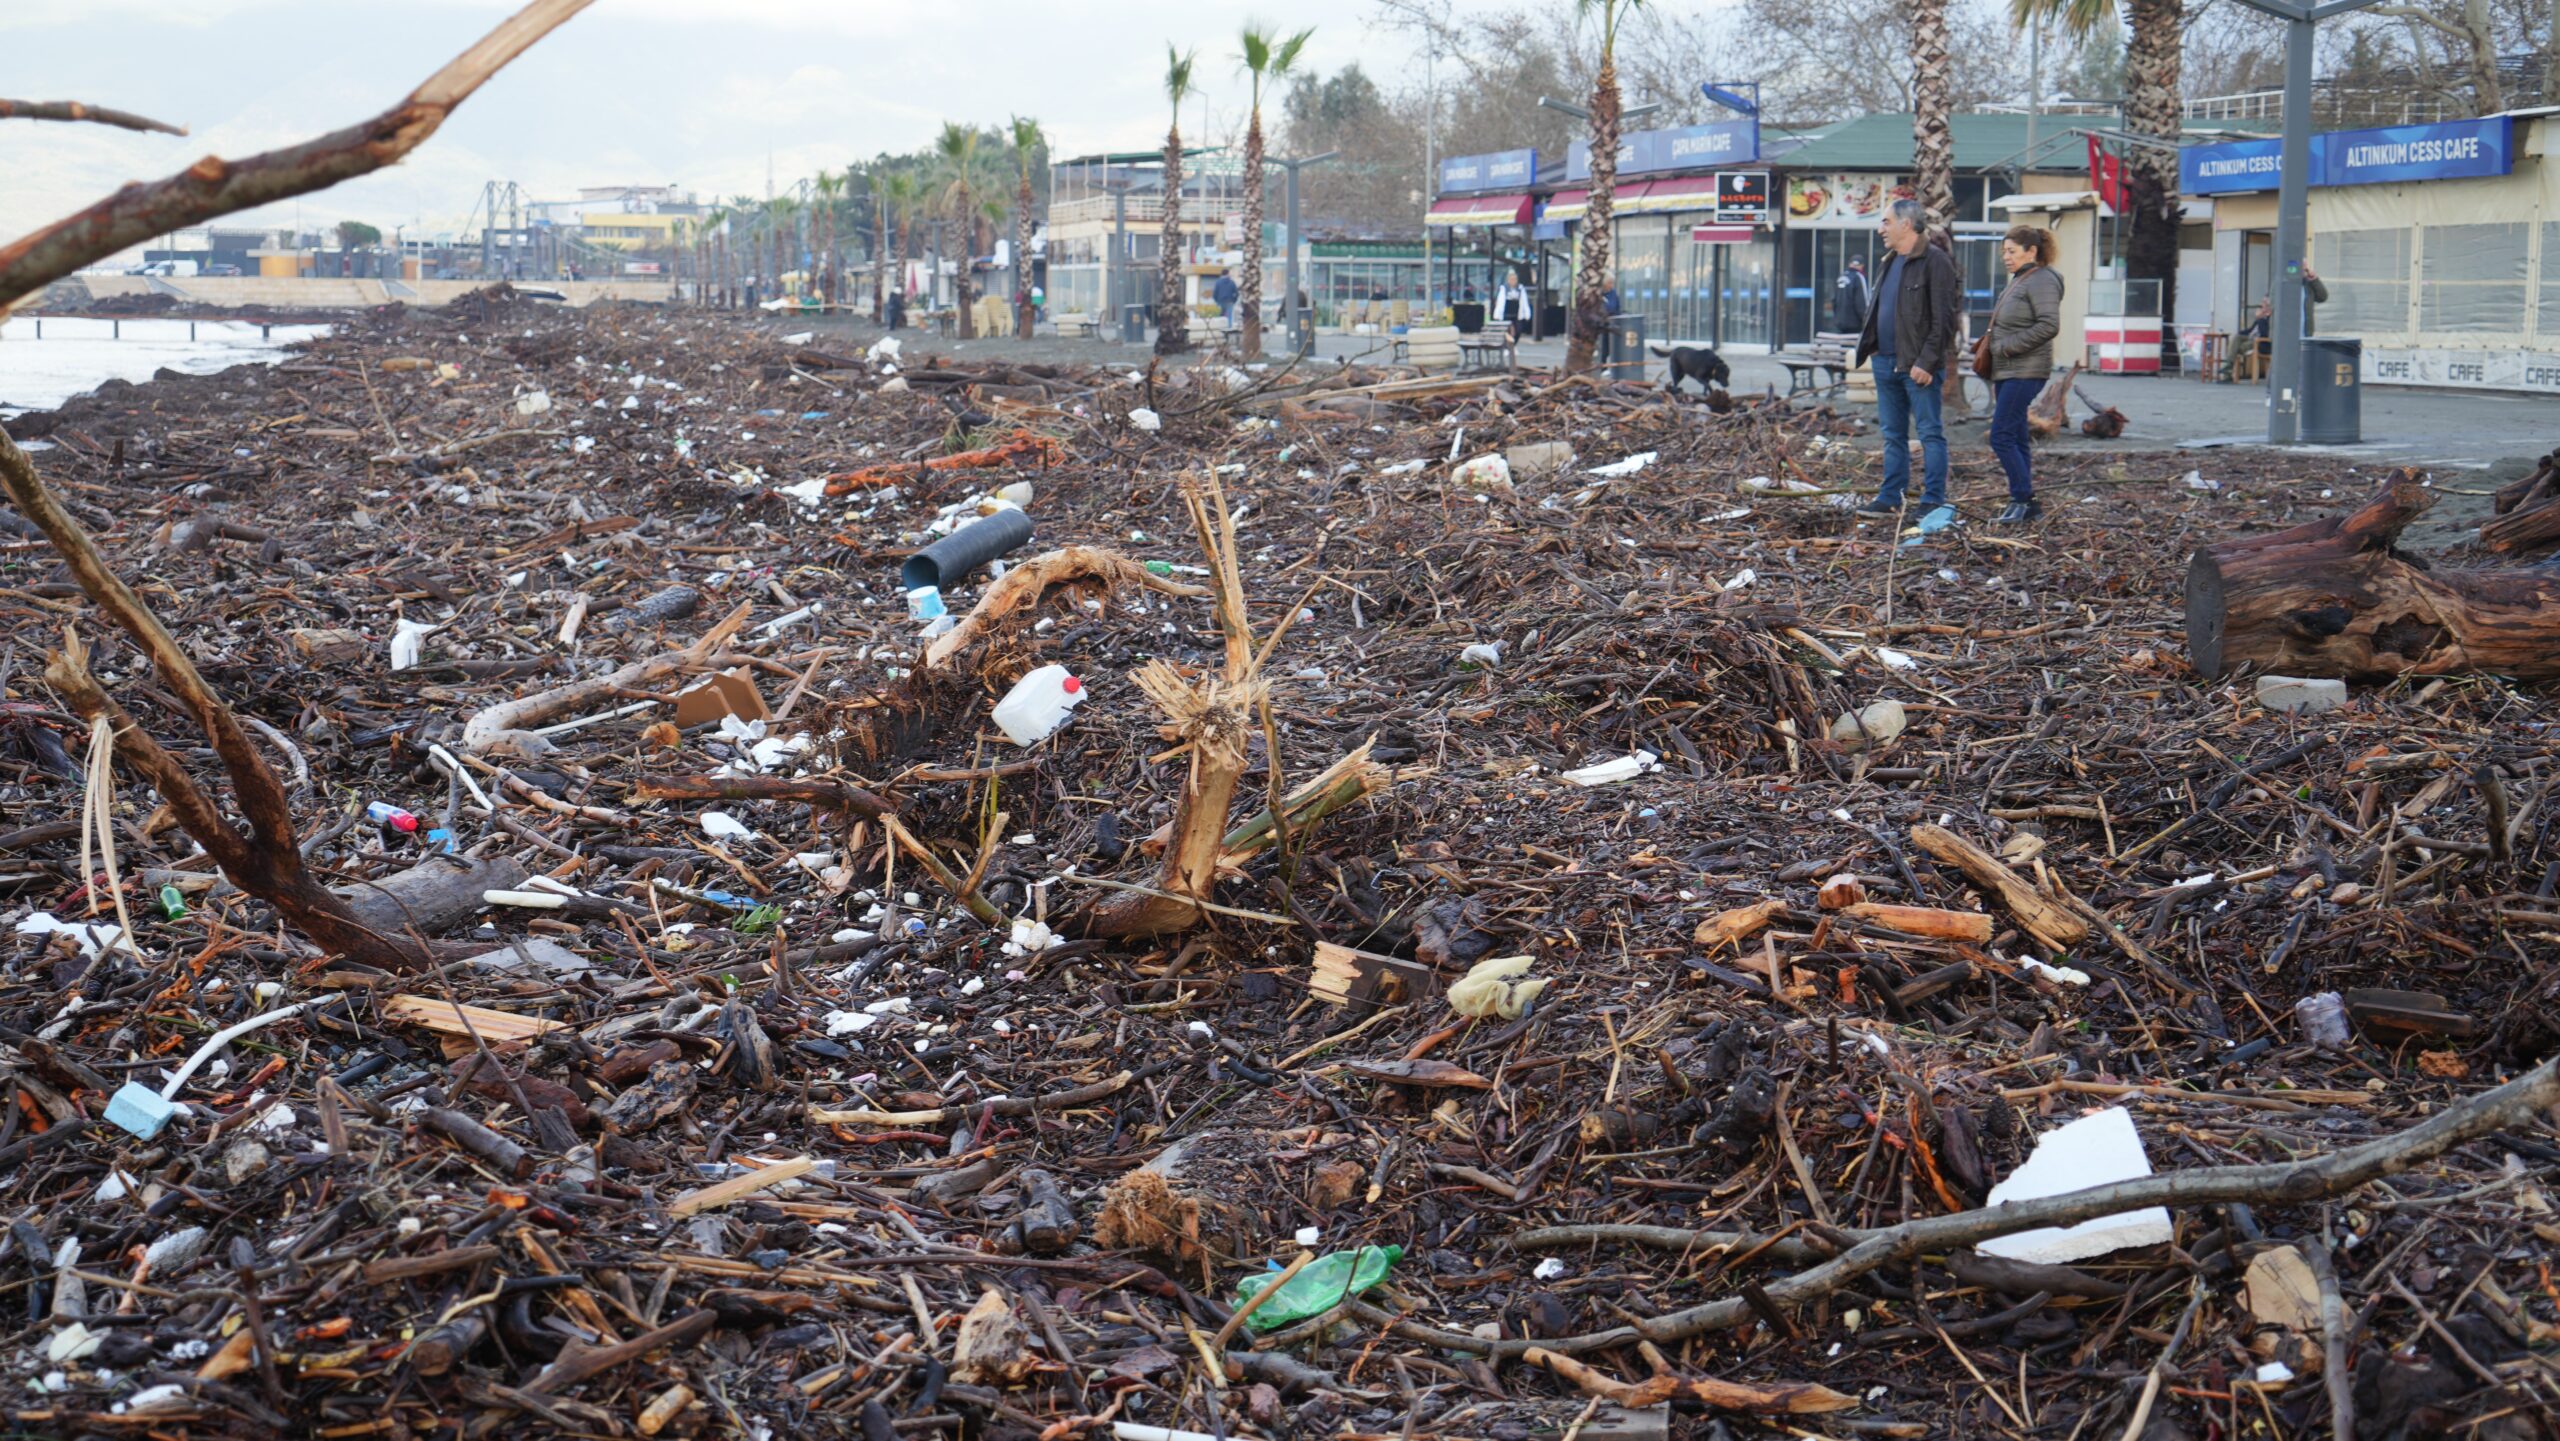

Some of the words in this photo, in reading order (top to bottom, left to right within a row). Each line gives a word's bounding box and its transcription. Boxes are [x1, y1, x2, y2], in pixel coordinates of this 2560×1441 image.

[1713, 132, 1732, 152] CAFE
[2347, 142, 2407, 168] ALTINKUM
[2410, 139, 2441, 162] CESS
[2444, 136, 2479, 161] CAFE
[2199, 159, 2247, 177] ALTINKUM
[2249, 156, 2275, 173] CESS
[2378, 361, 2409, 377] CAFE
[2449, 364, 2483, 381] CAFE
[2526, 367, 2560, 386] CAFE
